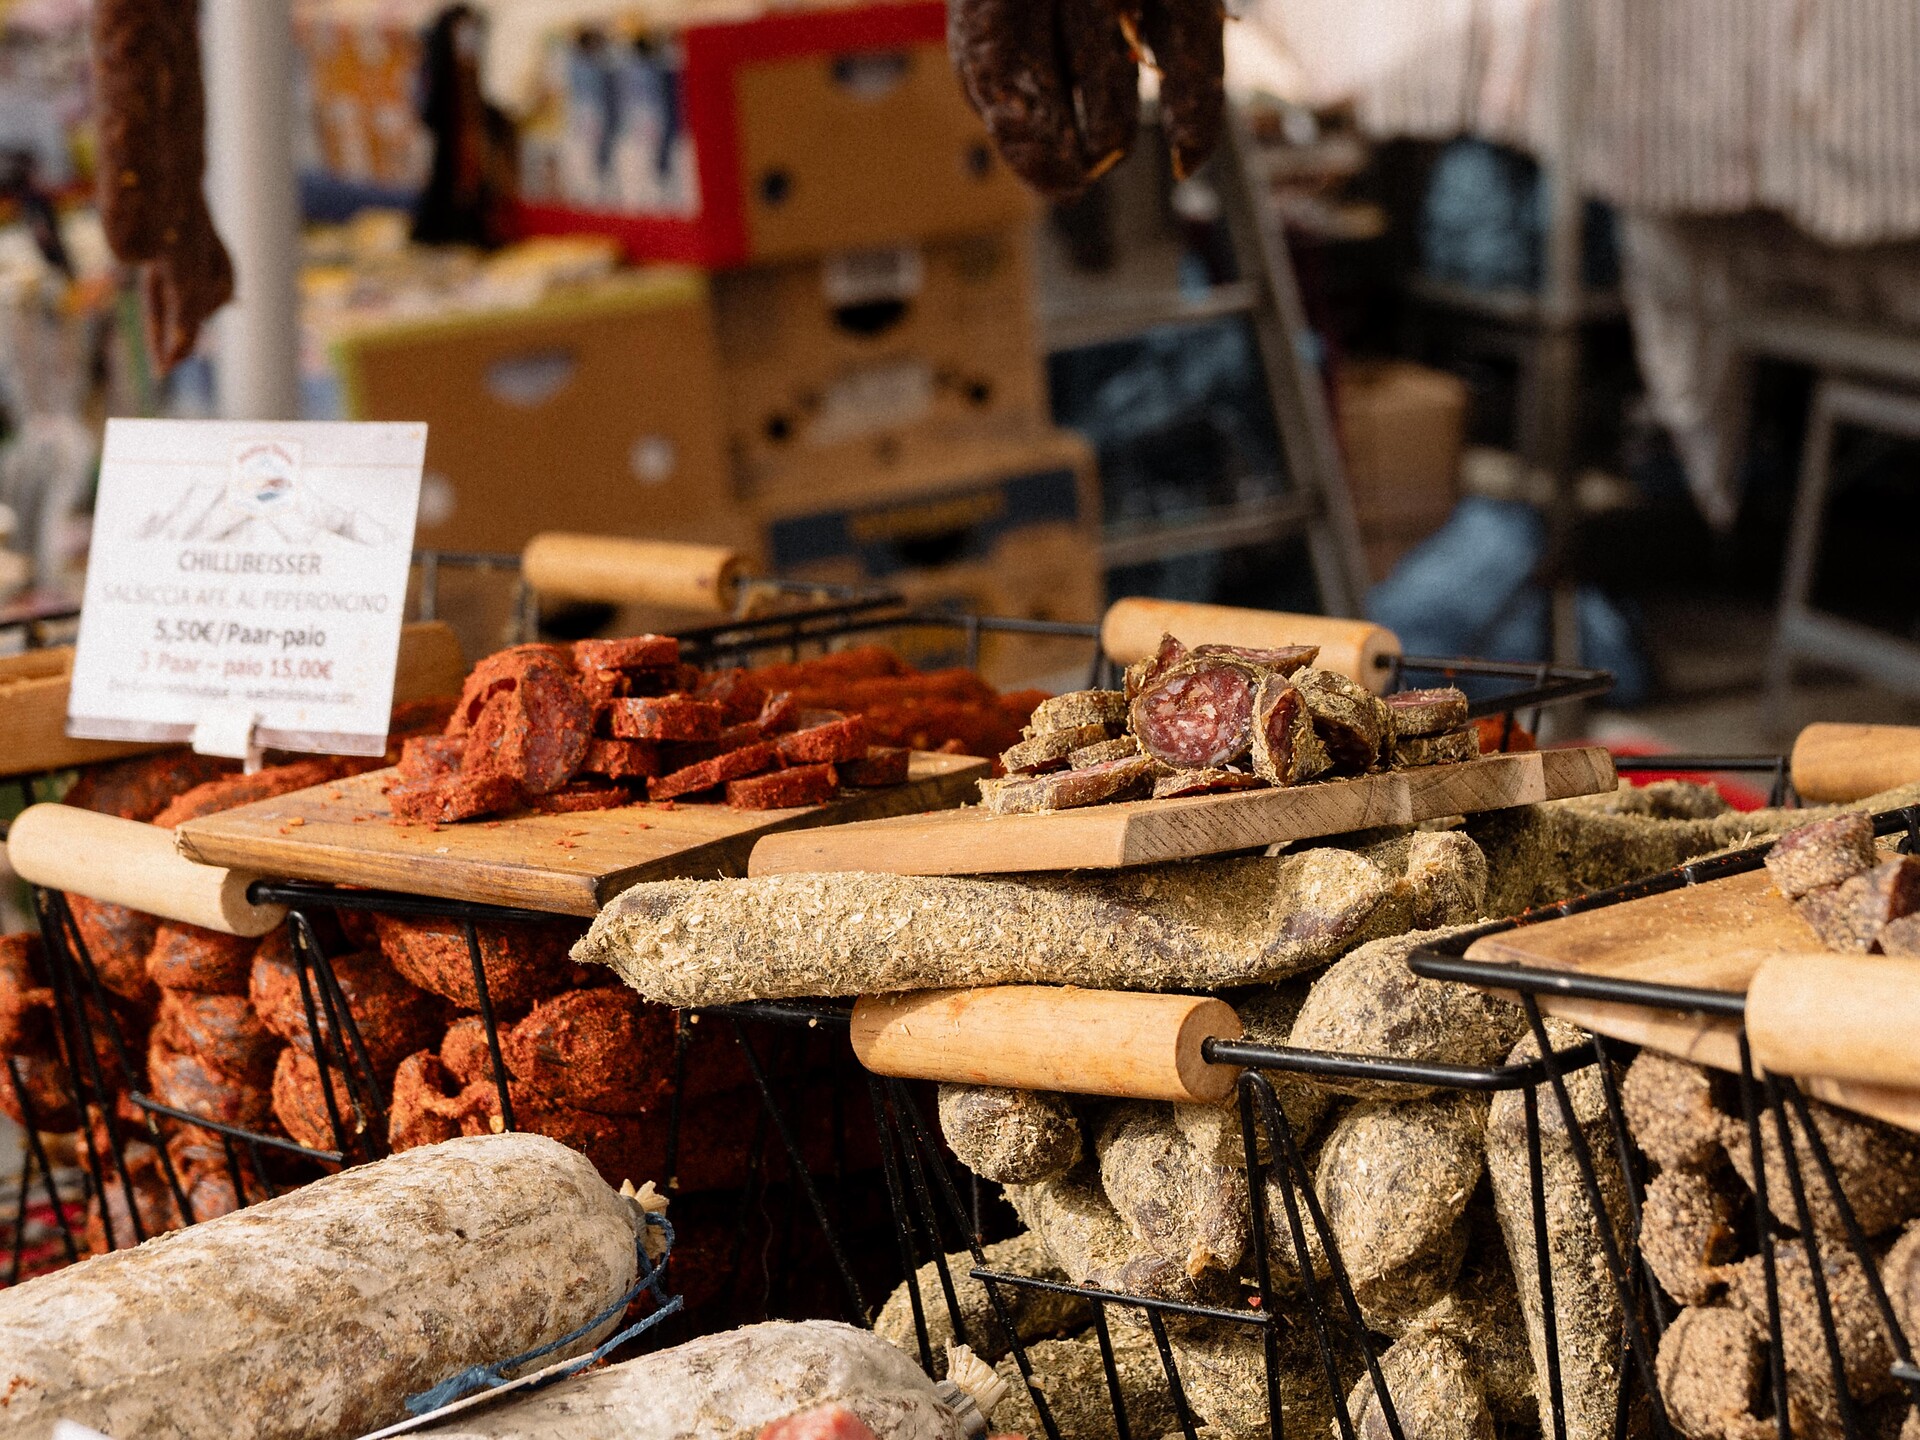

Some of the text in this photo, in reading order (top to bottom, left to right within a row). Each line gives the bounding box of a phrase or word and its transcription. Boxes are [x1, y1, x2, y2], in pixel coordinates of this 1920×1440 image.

[178, 549, 322, 575] CHILLIBEISSER
[157, 652, 202, 673] Paar
[223, 655, 263, 679] paio
[270, 658, 334, 682] 15,00€
